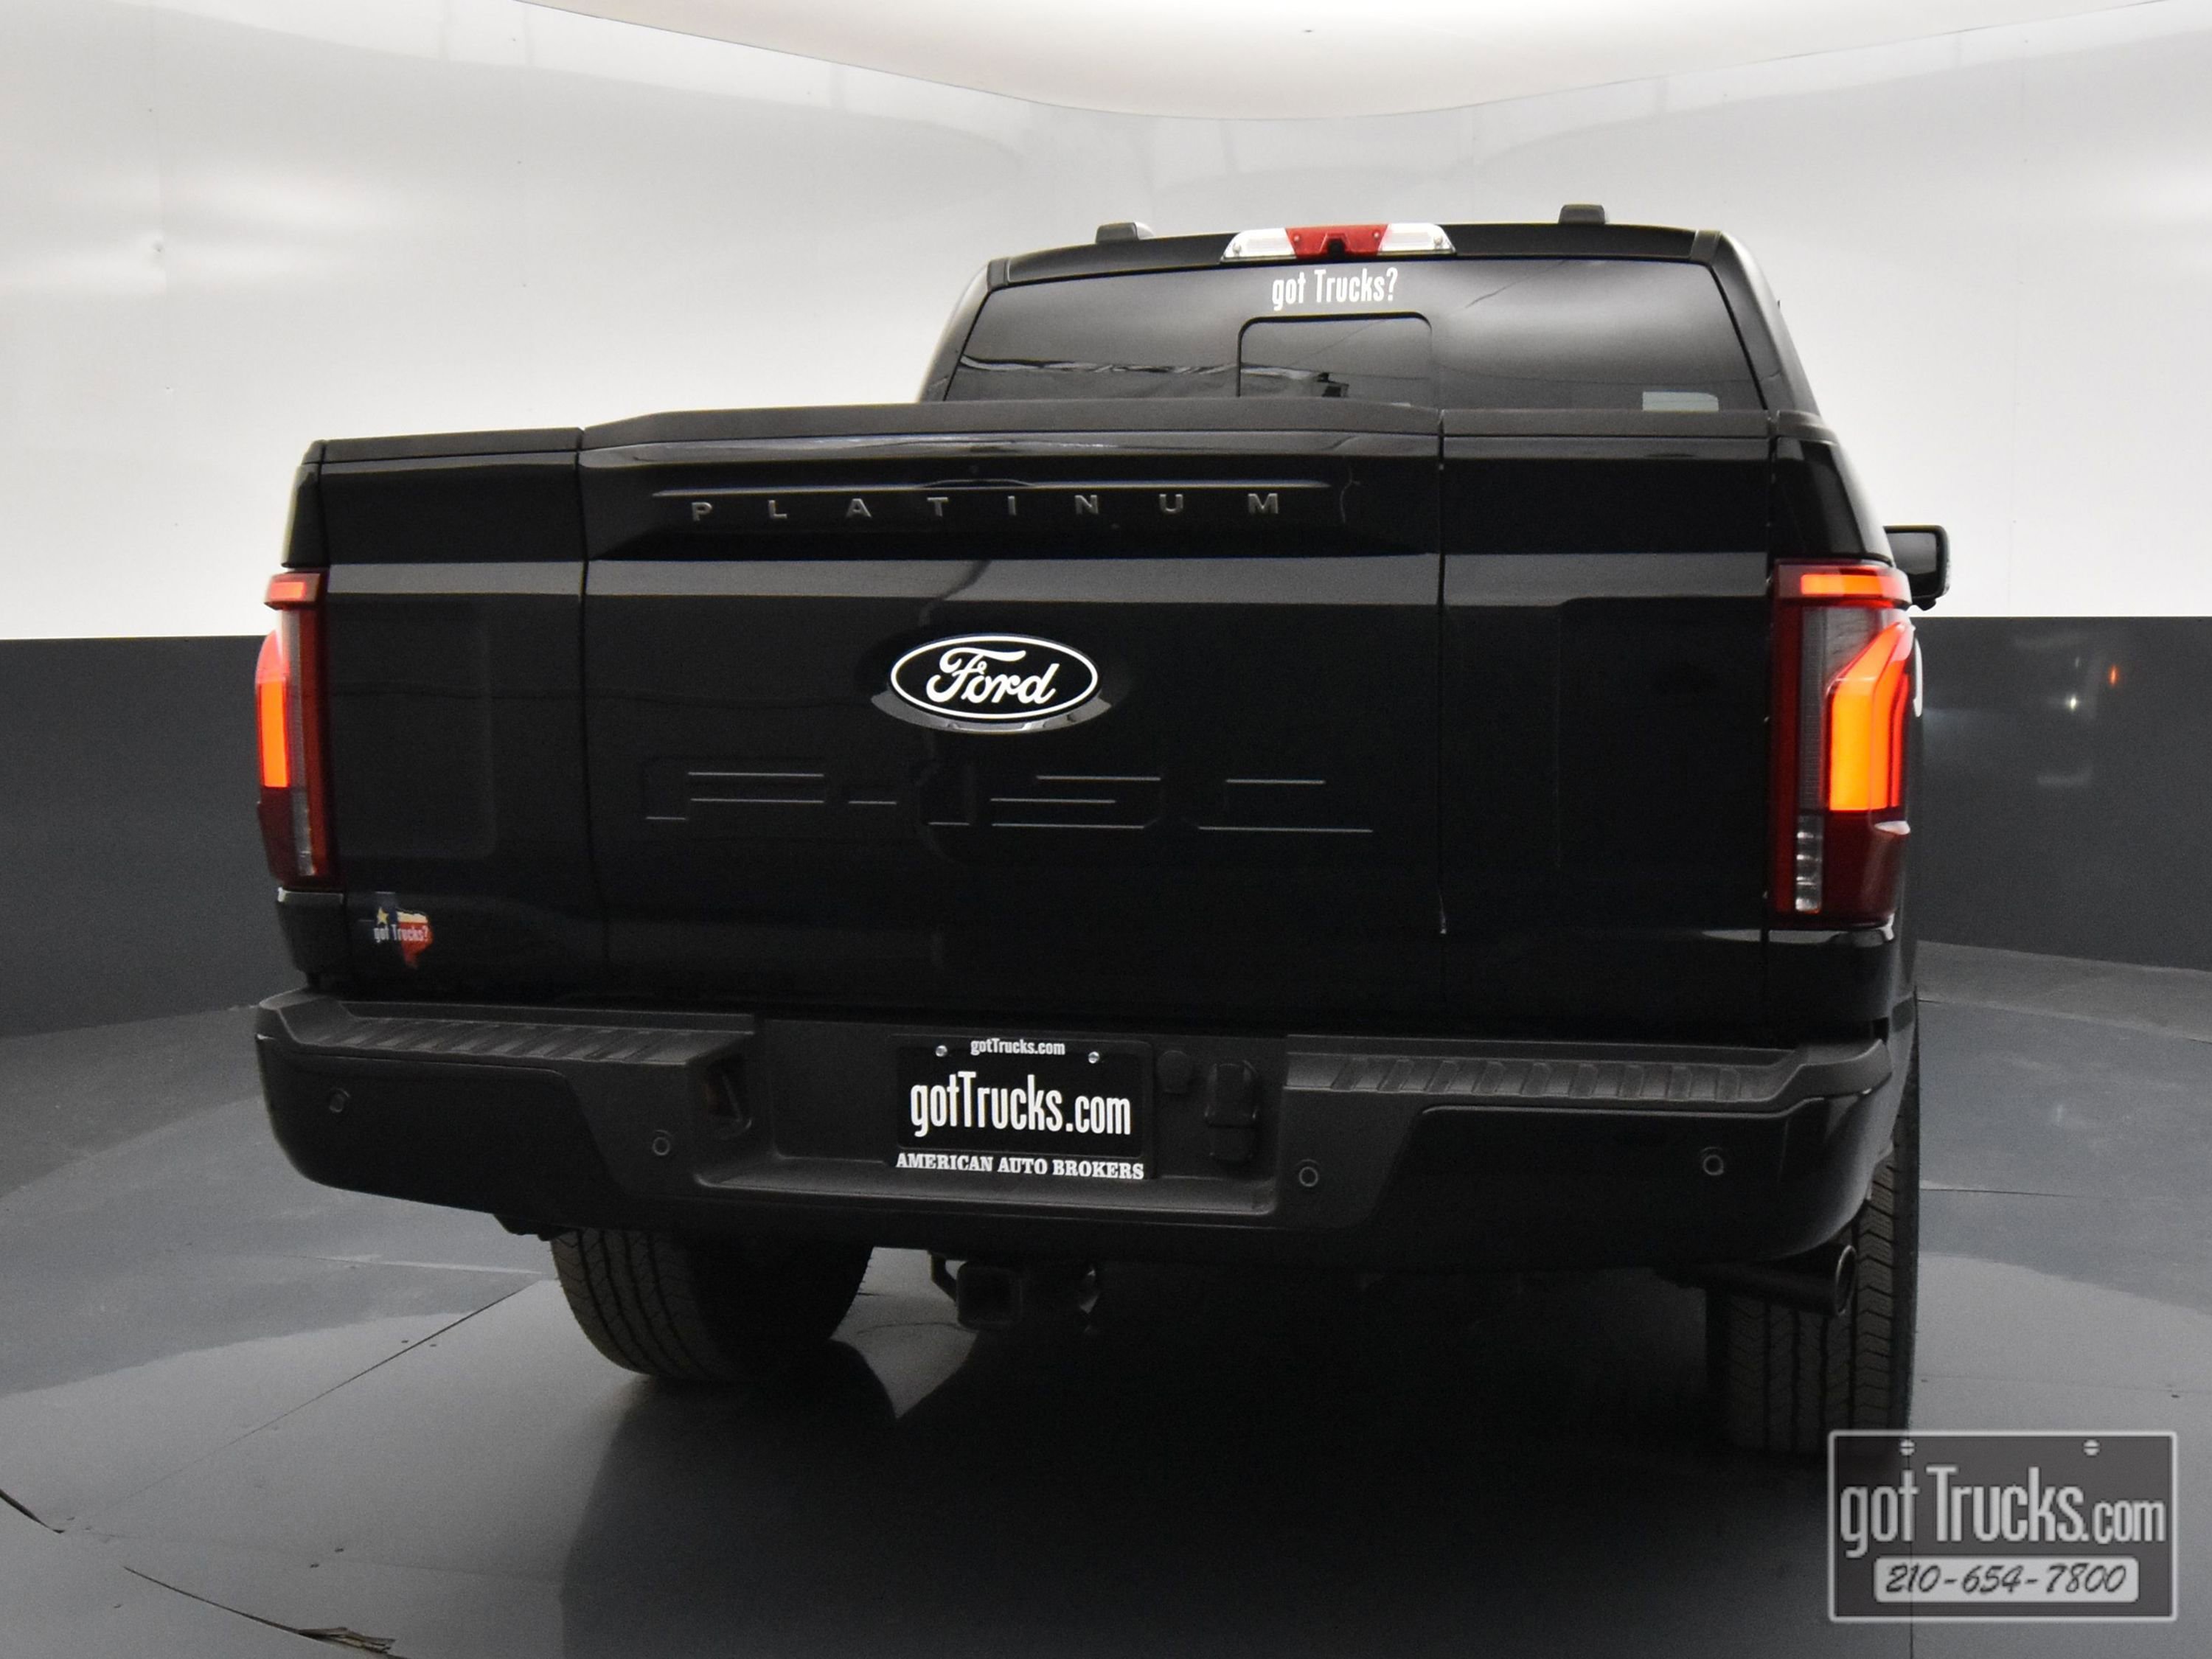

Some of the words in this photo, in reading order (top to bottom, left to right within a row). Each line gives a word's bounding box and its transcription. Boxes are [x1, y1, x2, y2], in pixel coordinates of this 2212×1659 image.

[1272, 271, 1306, 311] got
[1314, 267, 1399, 303] Trucks?
[690, 492, 1280, 522] PLATINUM
[925, 647, 1060, 704] Ford
[970, 1037, 1066, 1057] gotTrucks.com
[910, 1071, 1132, 1137] gotTrucks.com
[895, 1152, 994, 1172] AMERICAN
[997, 1157, 1048, 1175] AUTO
[1052, 1159, 1144, 1180] BROKERS
